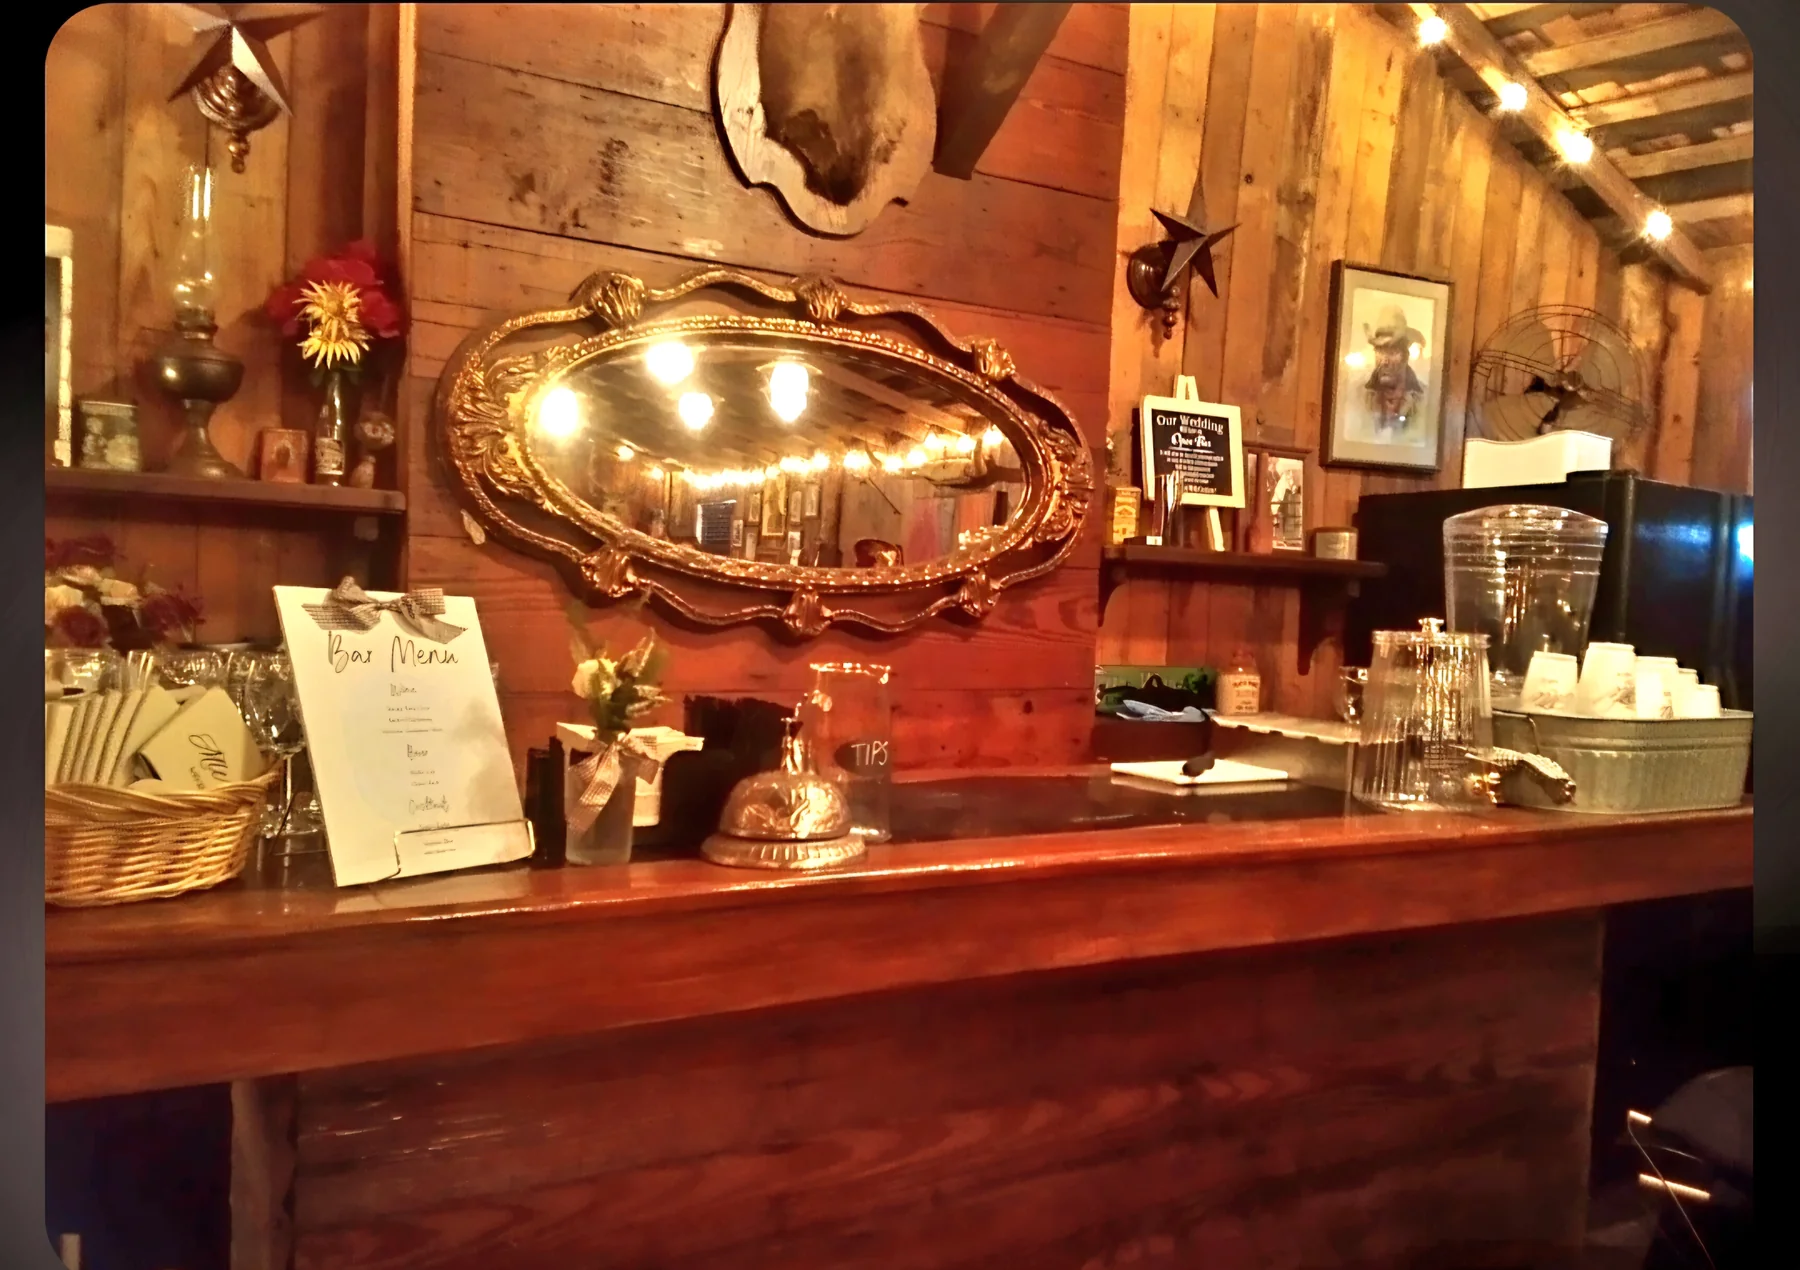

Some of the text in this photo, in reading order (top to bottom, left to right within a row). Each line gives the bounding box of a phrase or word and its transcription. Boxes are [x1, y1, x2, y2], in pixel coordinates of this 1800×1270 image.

[1156, 414, 1178, 426] Our
[1179, 414, 1225, 435] Wedding
[327, 630, 459, 674] Bar Menu
[850, 740, 889, 766] TIPS
